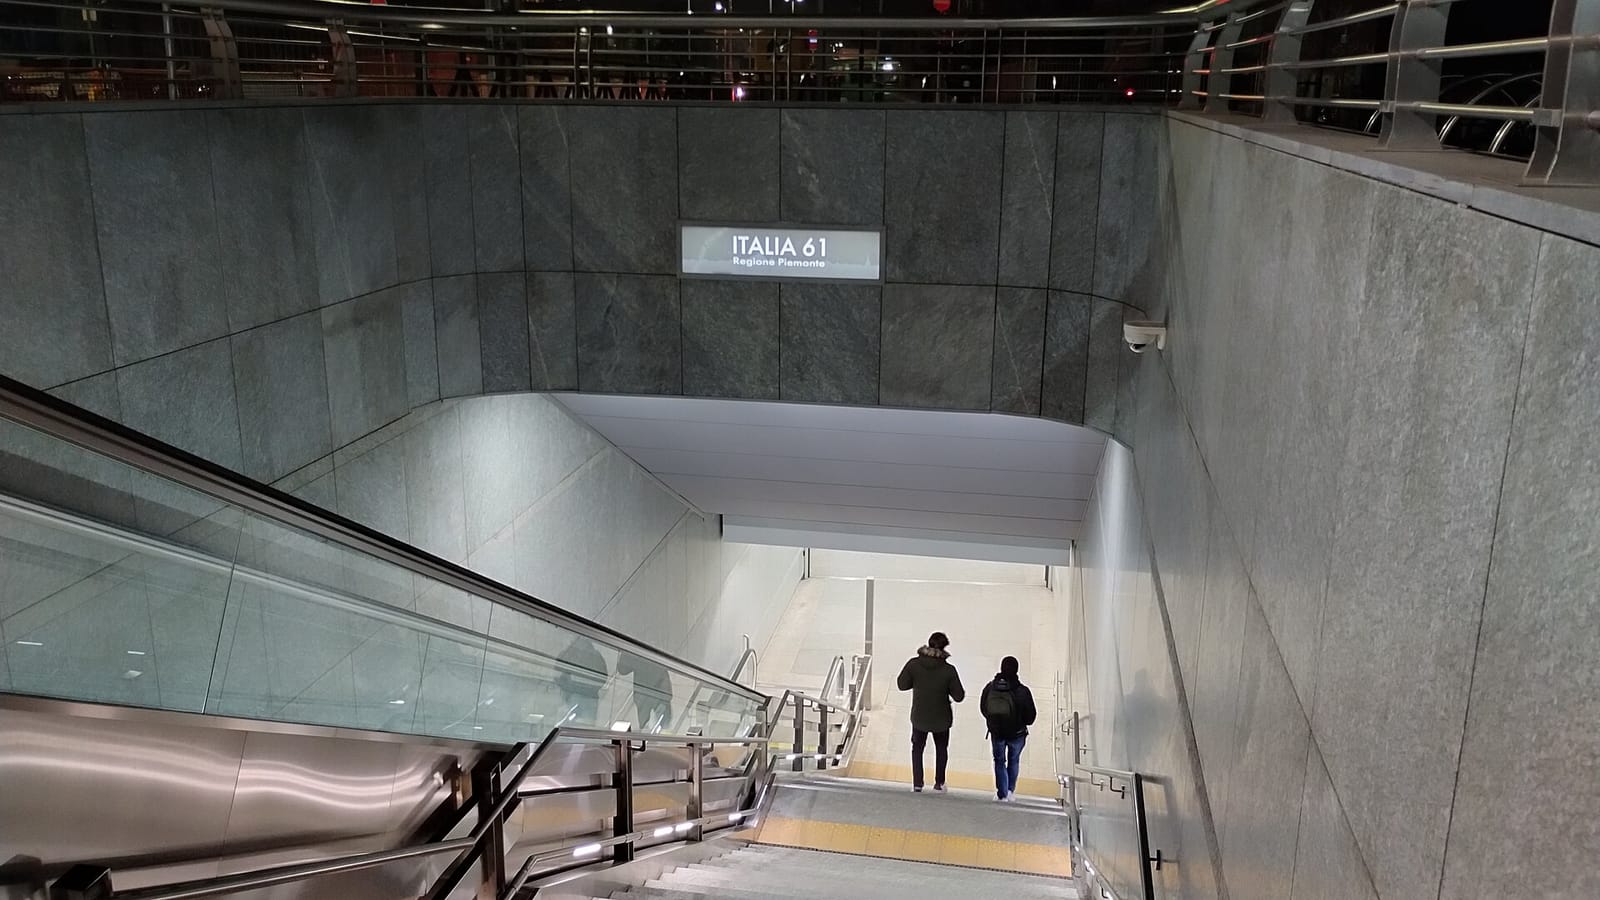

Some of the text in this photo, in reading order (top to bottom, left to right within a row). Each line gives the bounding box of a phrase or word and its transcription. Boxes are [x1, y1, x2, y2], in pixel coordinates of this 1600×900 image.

[732, 235, 827, 257] ITALIA 61
[733, 257, 825, 268] Regione Piemonte
